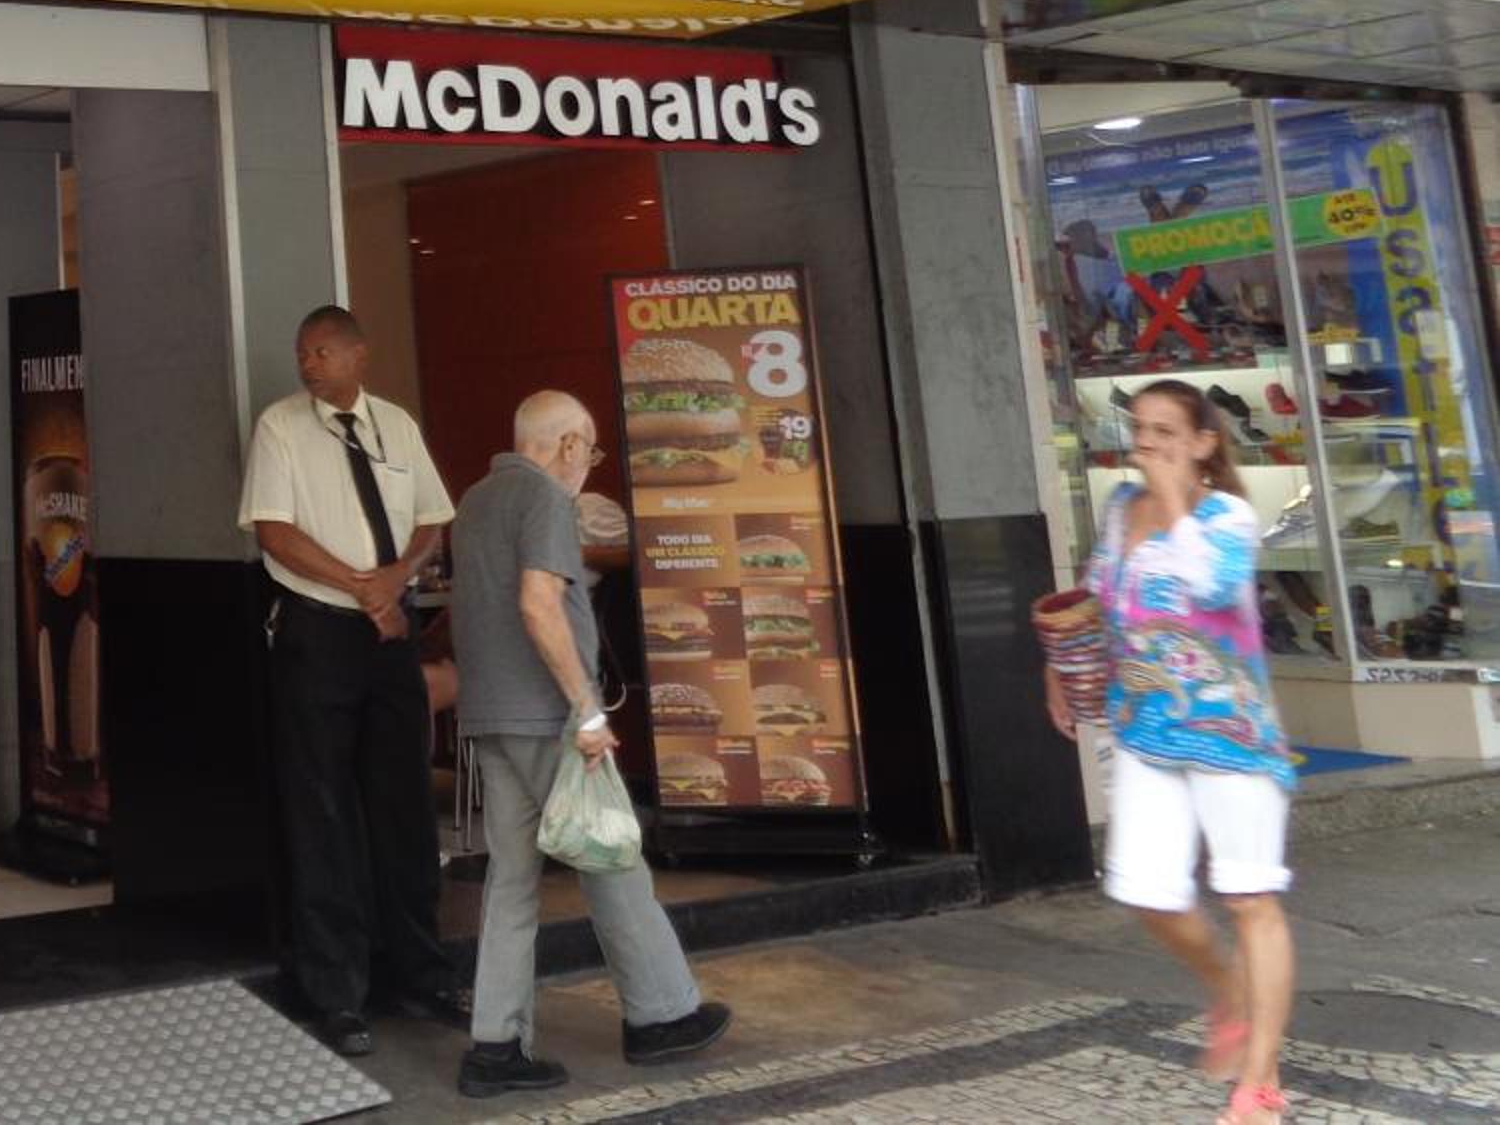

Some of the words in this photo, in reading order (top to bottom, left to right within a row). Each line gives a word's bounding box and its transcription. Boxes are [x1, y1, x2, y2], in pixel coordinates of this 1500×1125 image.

[343, 57, 820, 146] McDonald's
[1129, 208, 1270, 260] PROMOÇÃ
[727, 276, 757, 292] DO
[761, 273, 797, 291] DIA
[627, 293, 801, 331] QUARTA
[747, 330, 808, 398] 8
